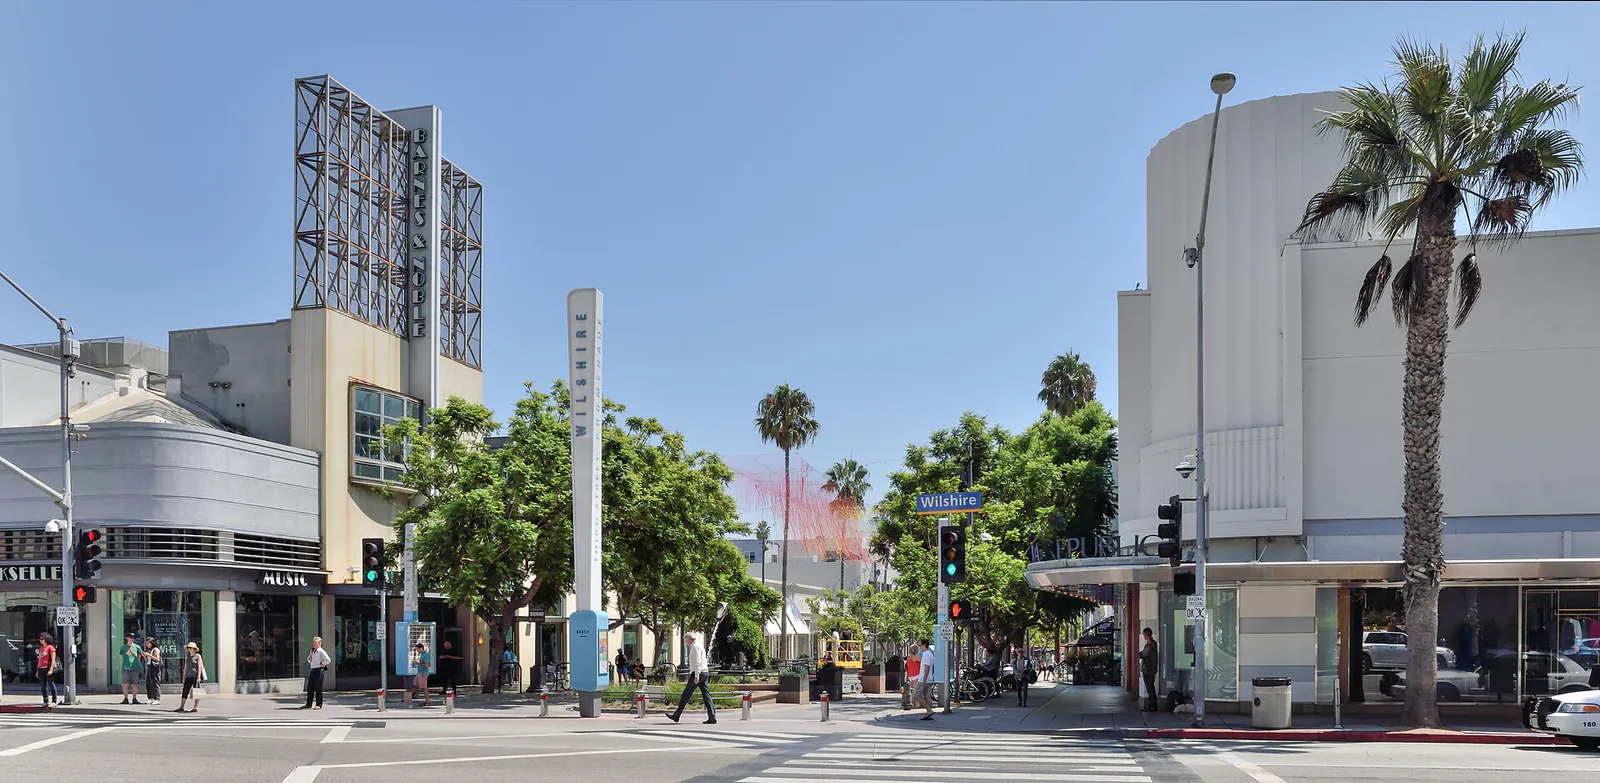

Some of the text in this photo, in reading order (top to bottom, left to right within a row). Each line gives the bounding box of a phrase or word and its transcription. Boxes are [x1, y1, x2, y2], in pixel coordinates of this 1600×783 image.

[412, 128, 427, 338] BARNES & NOBLE
[575, 313, 587, 438] WILSHIRE
[920, 494, 977, 508] Wilshire
[1048, 534, 1164, 560] EPUBLIC
[0, 566, 62, 581] KSELLE
[262, 571, 308, 587] MUSIC
[58, 616, 67, 625] OK
[1187, 608, 1195, 618] OK
